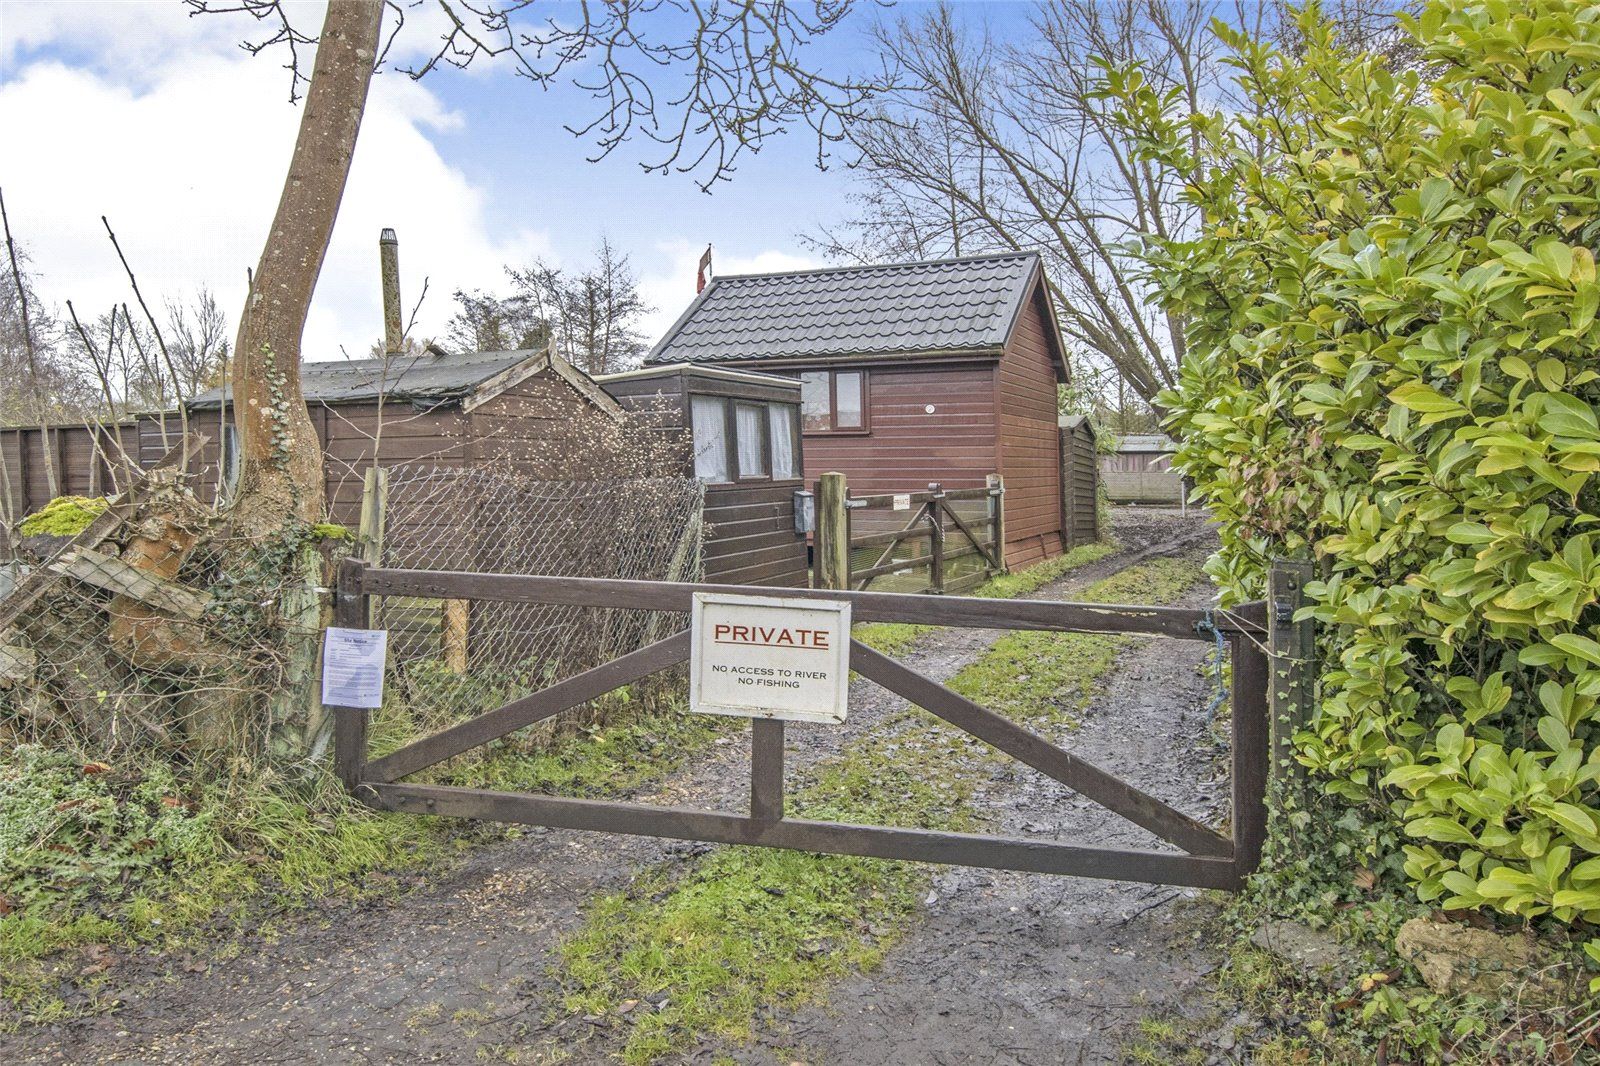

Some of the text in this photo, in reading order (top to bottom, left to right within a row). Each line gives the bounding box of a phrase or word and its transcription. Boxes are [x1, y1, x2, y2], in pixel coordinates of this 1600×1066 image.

[715, 624, 829, 646] PRIVATE
[712, 664, 827, 680] NO ACCESS TO RIVER
[737, 677, 800, 689] NO FISHING
